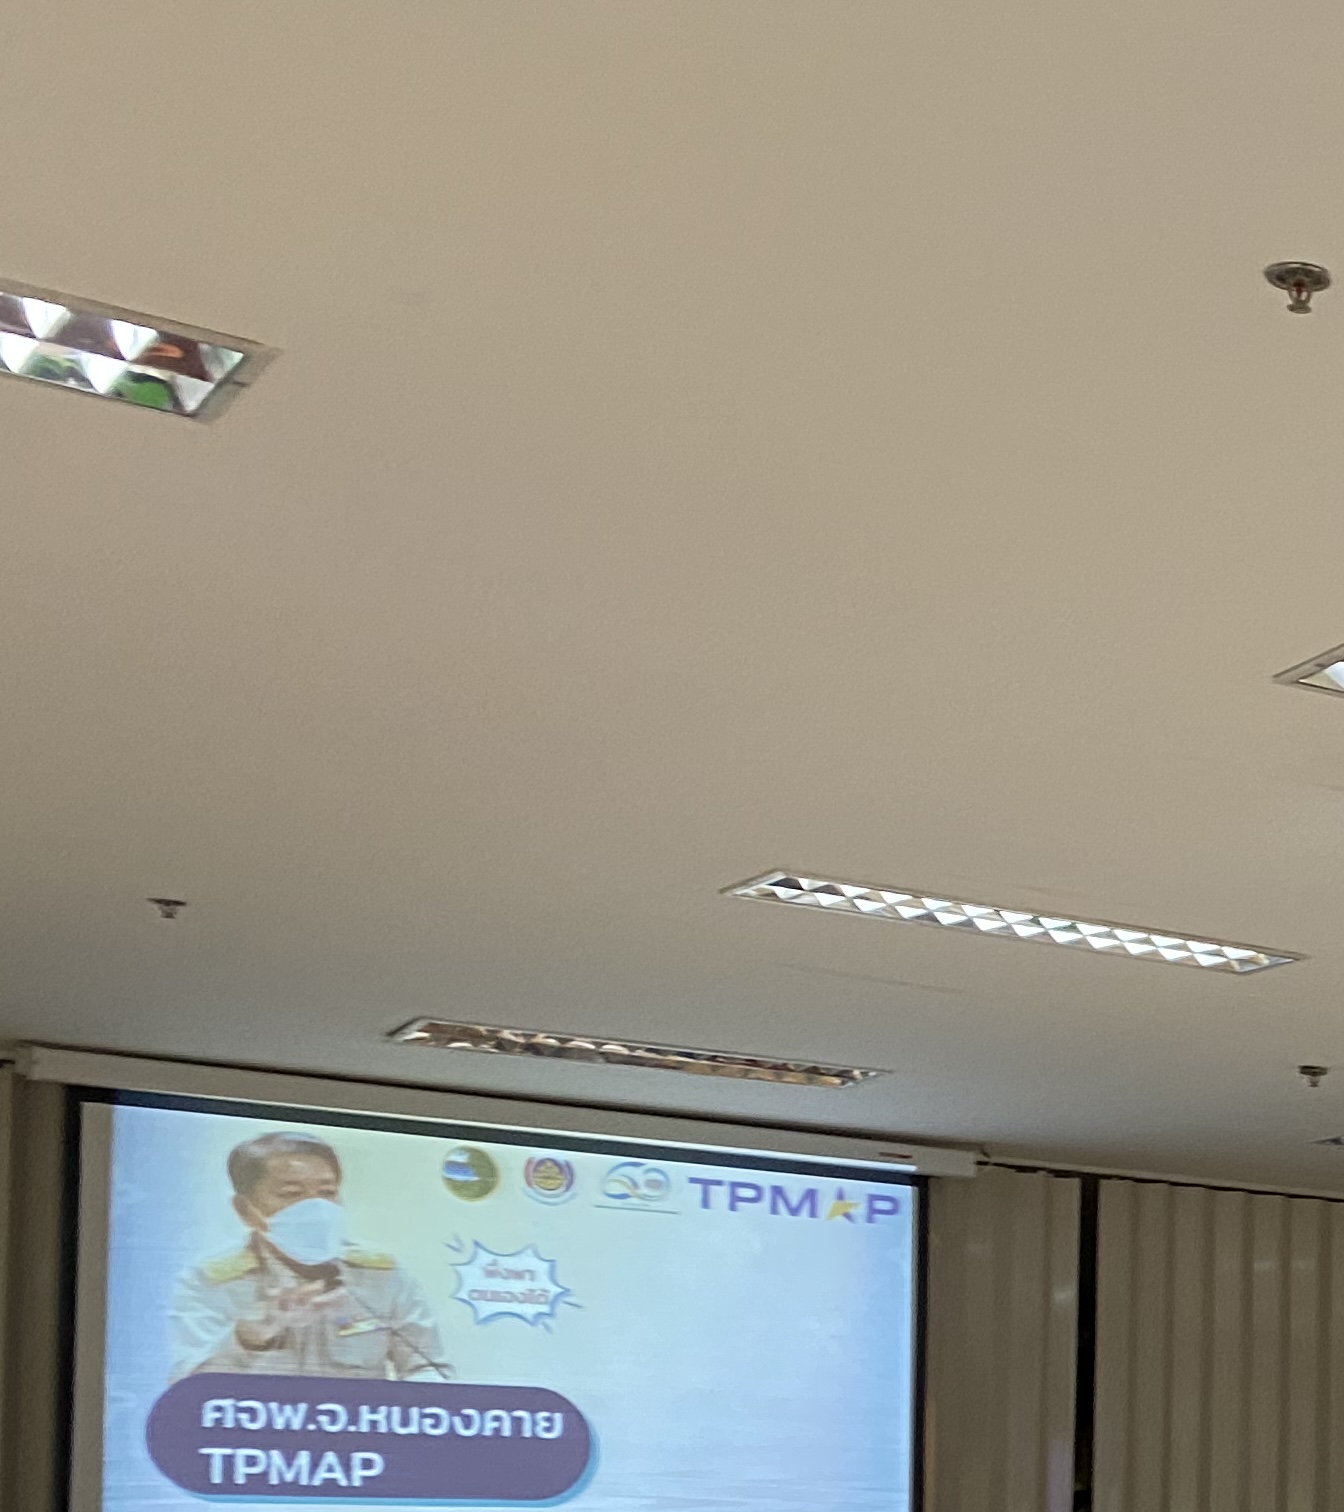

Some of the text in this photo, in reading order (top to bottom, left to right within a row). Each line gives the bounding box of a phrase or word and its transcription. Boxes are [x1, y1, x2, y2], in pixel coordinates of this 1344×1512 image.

[201, 1398, 565, 1440] ศจพ.จ.หนองคาย
[199, 1447, 385, 1488] TPMAP
